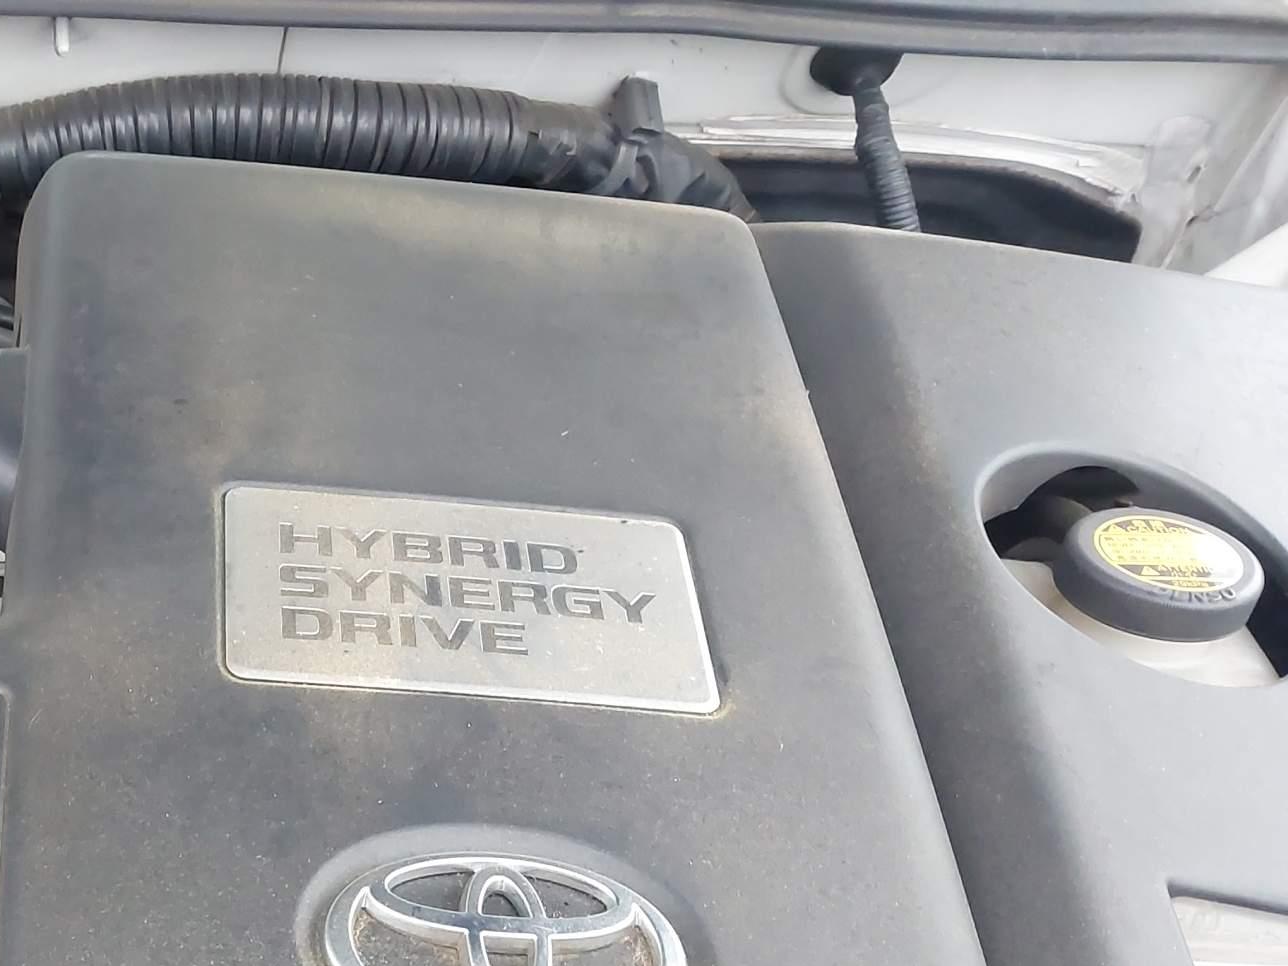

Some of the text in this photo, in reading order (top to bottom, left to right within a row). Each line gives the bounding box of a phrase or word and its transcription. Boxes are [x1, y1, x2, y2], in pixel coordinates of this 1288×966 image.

[278, 521, 579, 575] HYBRID
[278, 563, 657, 624] SYNERGY
[279, 605, 530, 657] DRIVE
